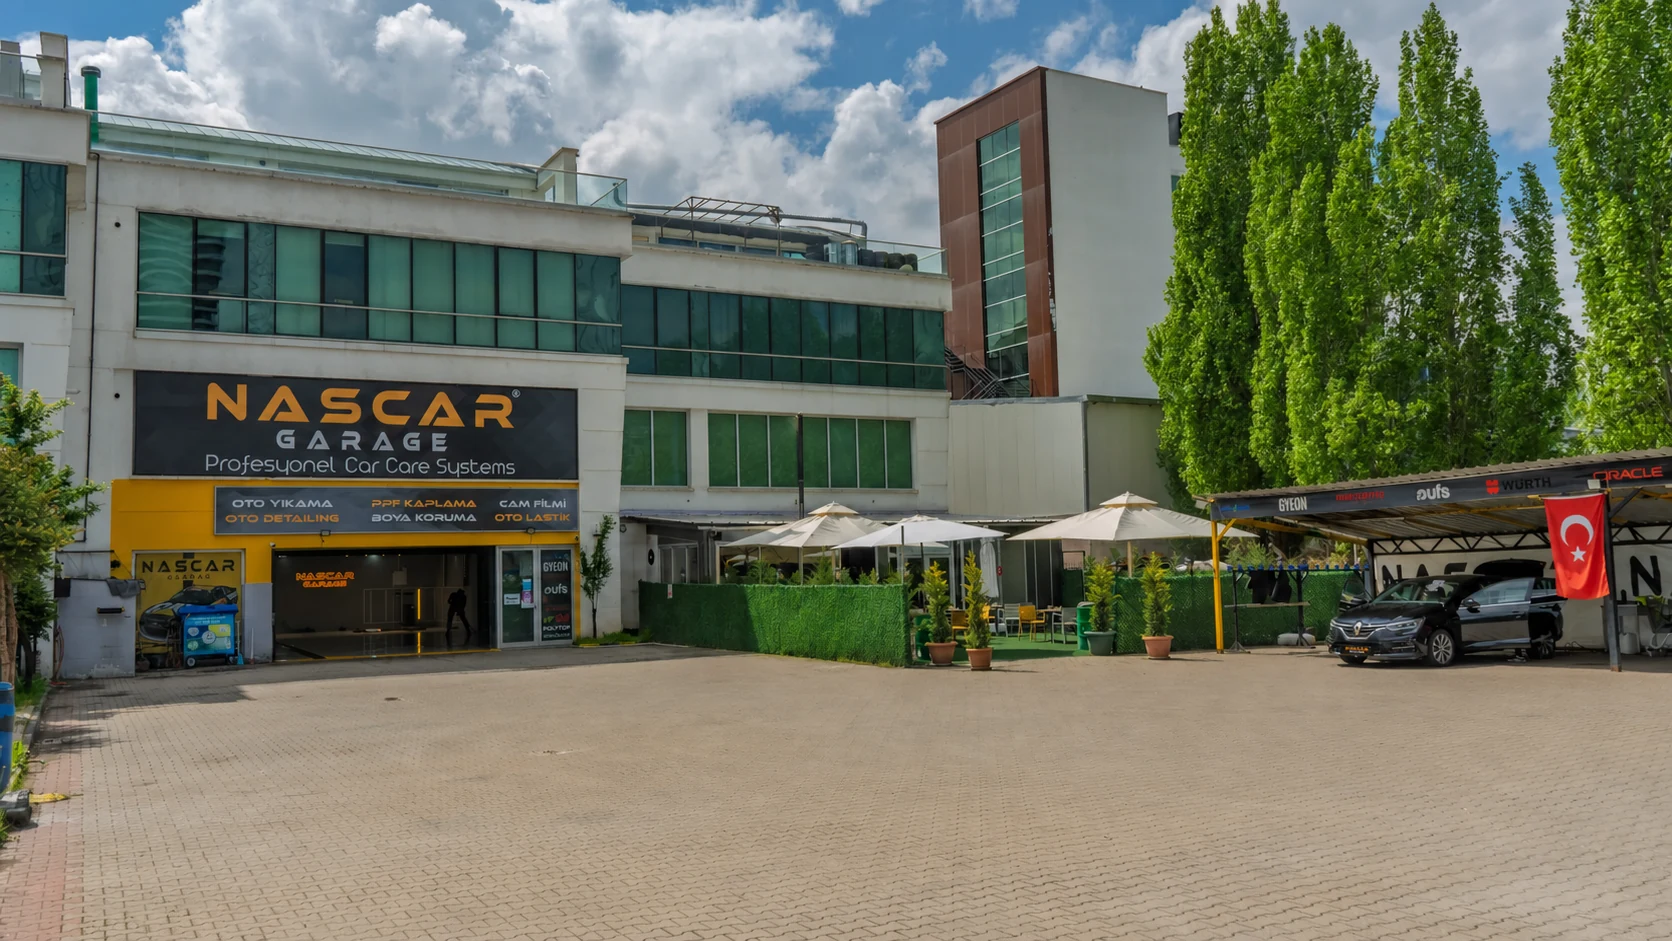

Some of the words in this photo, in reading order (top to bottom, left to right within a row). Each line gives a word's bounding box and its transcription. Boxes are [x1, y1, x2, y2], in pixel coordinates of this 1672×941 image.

[206, 382, 515, 429] NASCAR
[276, 429, 448, 452] GARAGE
[205, 454, 336, 476] Profesyonel
[344, 456, 380, 474] Car
[385, 457, 431, 475] Care
[436, 458, 516, 478] Systems
[1592, 466, 1664, 482] ORACLE
[1502, 477, 1552, 491] WÜRTH
[232, 499, 265, 508] OTO
[270, 499, 334, 508] YIKAMA
[371, 499, 400, 508] PPF
[404, 499, 477, 508] KAPLAMA
[499, 499, 530, 508] CAM
[534, 498, 566, 508] FİLMİ
[1278, 496, 1308, 512] GYEON
[225, 514, 259, 523] OTO
[263, 514, 340, 523] DETAILING
[371, 513, 411, 522] BOYA
[415, 513, 477, 522] KORUMA
[494, 513, 523, 522] OTO
[526, 512, 571, 522] LASTİK
[141, 560, 235, 573] NASCAR
[543, 561, 568, 573] GYEON
[295, 571, 355, 581] NASCAR
[544, 583, 568, 595] oufs
